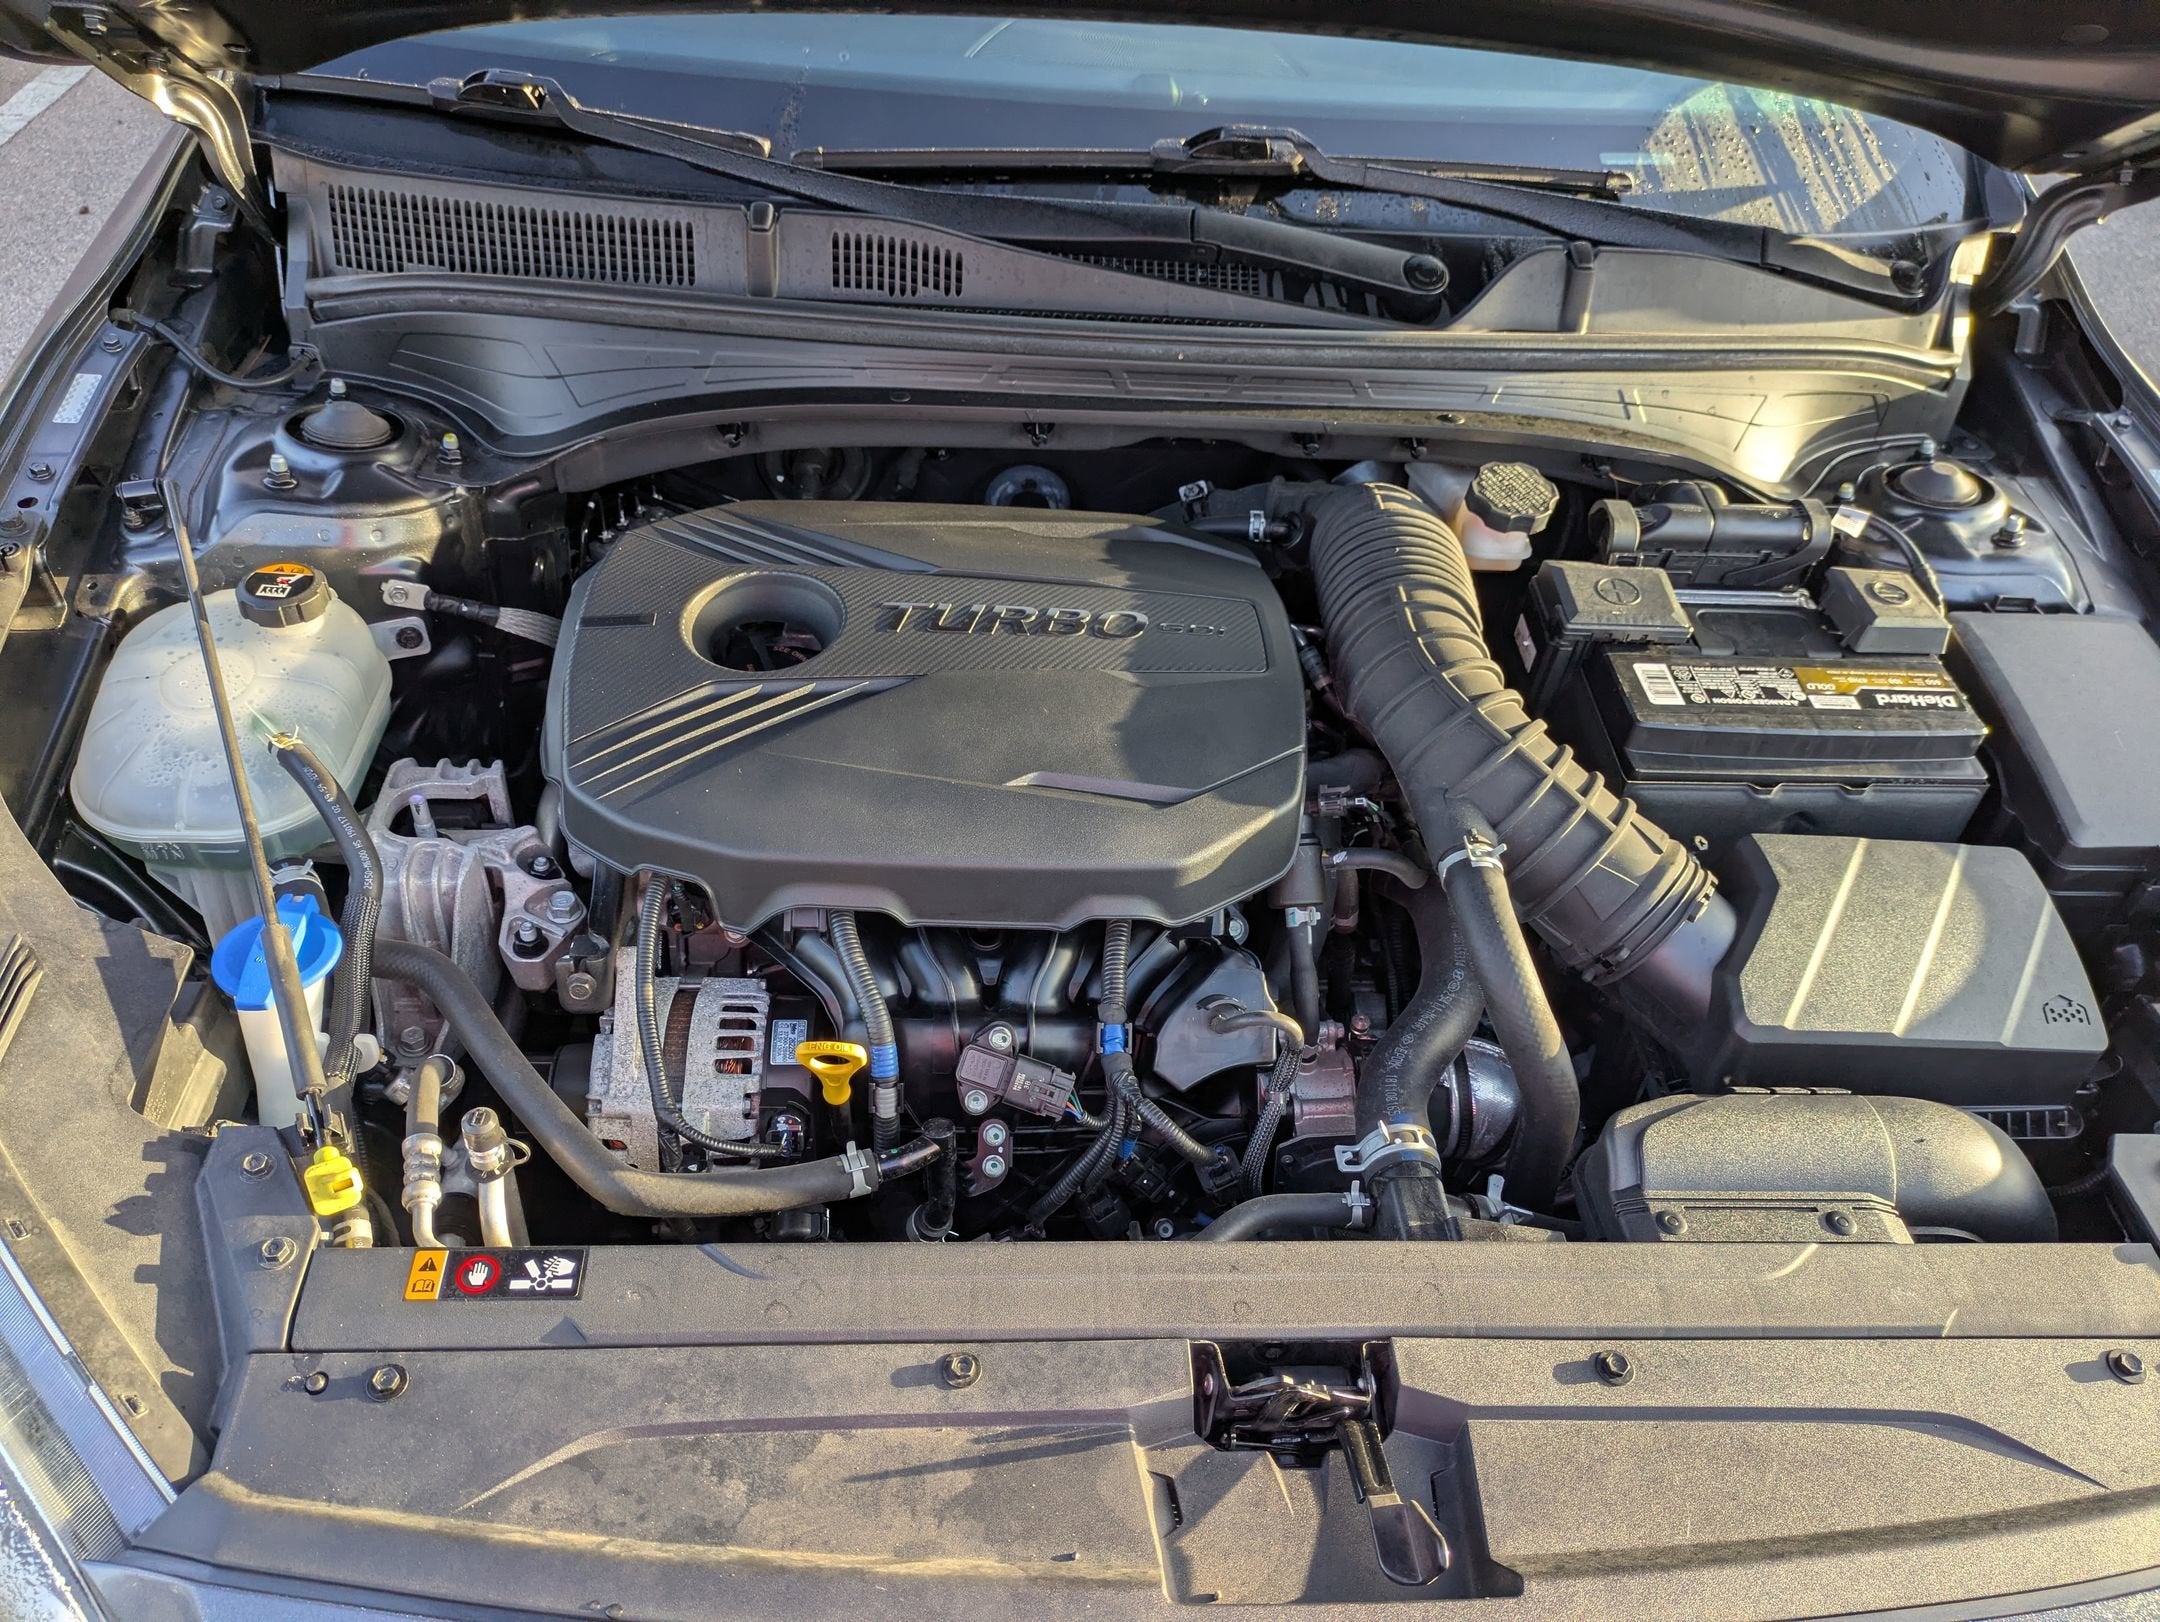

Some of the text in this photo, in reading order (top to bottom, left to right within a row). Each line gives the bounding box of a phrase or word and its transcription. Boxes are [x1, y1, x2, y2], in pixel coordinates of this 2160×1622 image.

[879, 600, 1149, 640] TURBO
[1806, 682, 1836, 691] GOLD
[1876, 693, 1957, 708] DieHard
[809, 1043, 831, 1051] ENG
